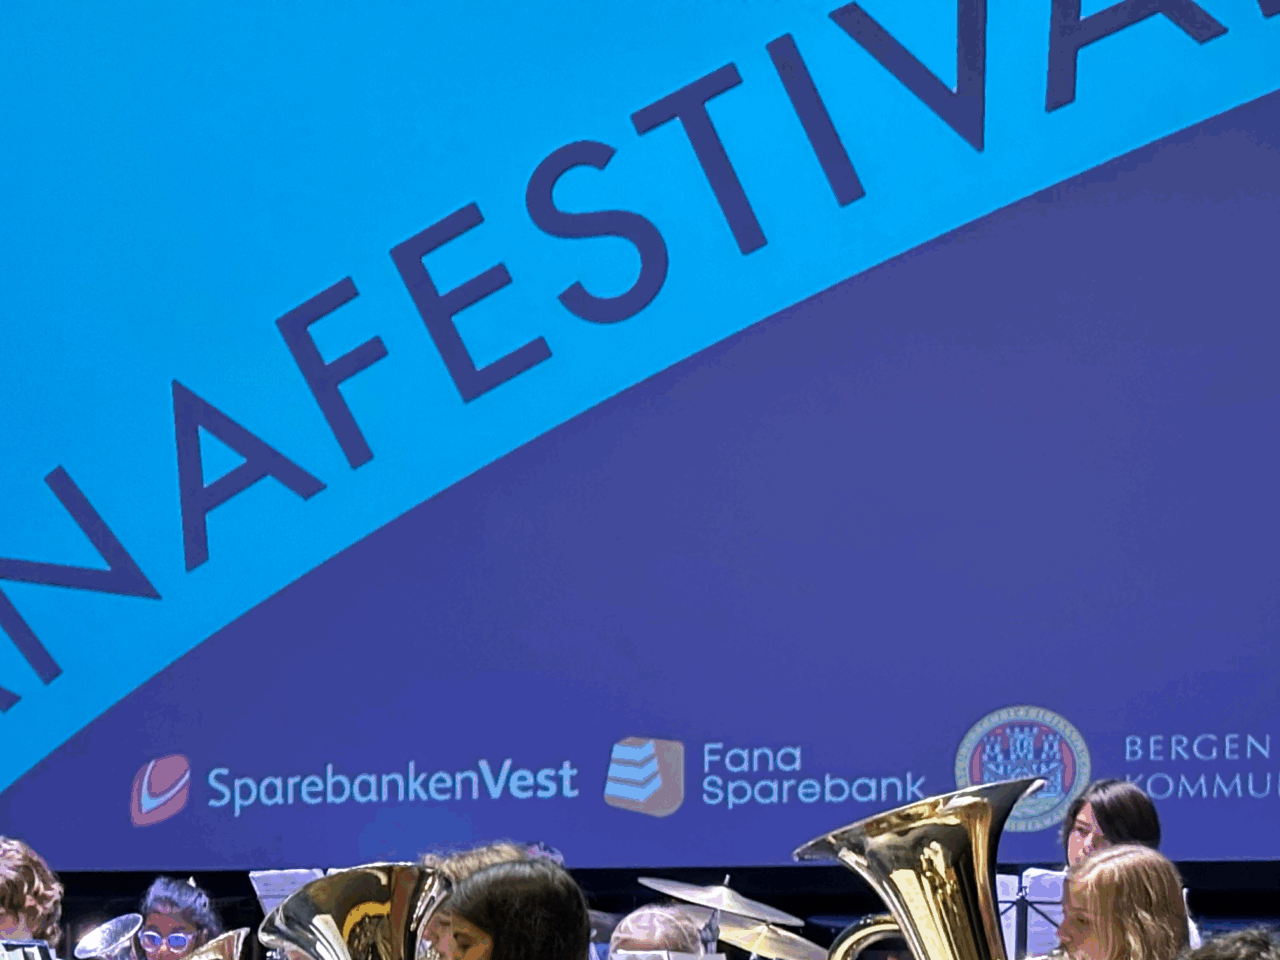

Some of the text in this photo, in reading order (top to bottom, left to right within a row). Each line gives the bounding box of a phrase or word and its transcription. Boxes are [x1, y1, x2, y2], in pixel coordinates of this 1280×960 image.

[703, 742, 802, 774] Fana
[1124, 733, 1271, 761] BERGEN
[208, 759, 579, 817] SparebankenVest
[702, 771, 926, 810] Sparebank
[1125, 772, 1280, 800] OMMU
